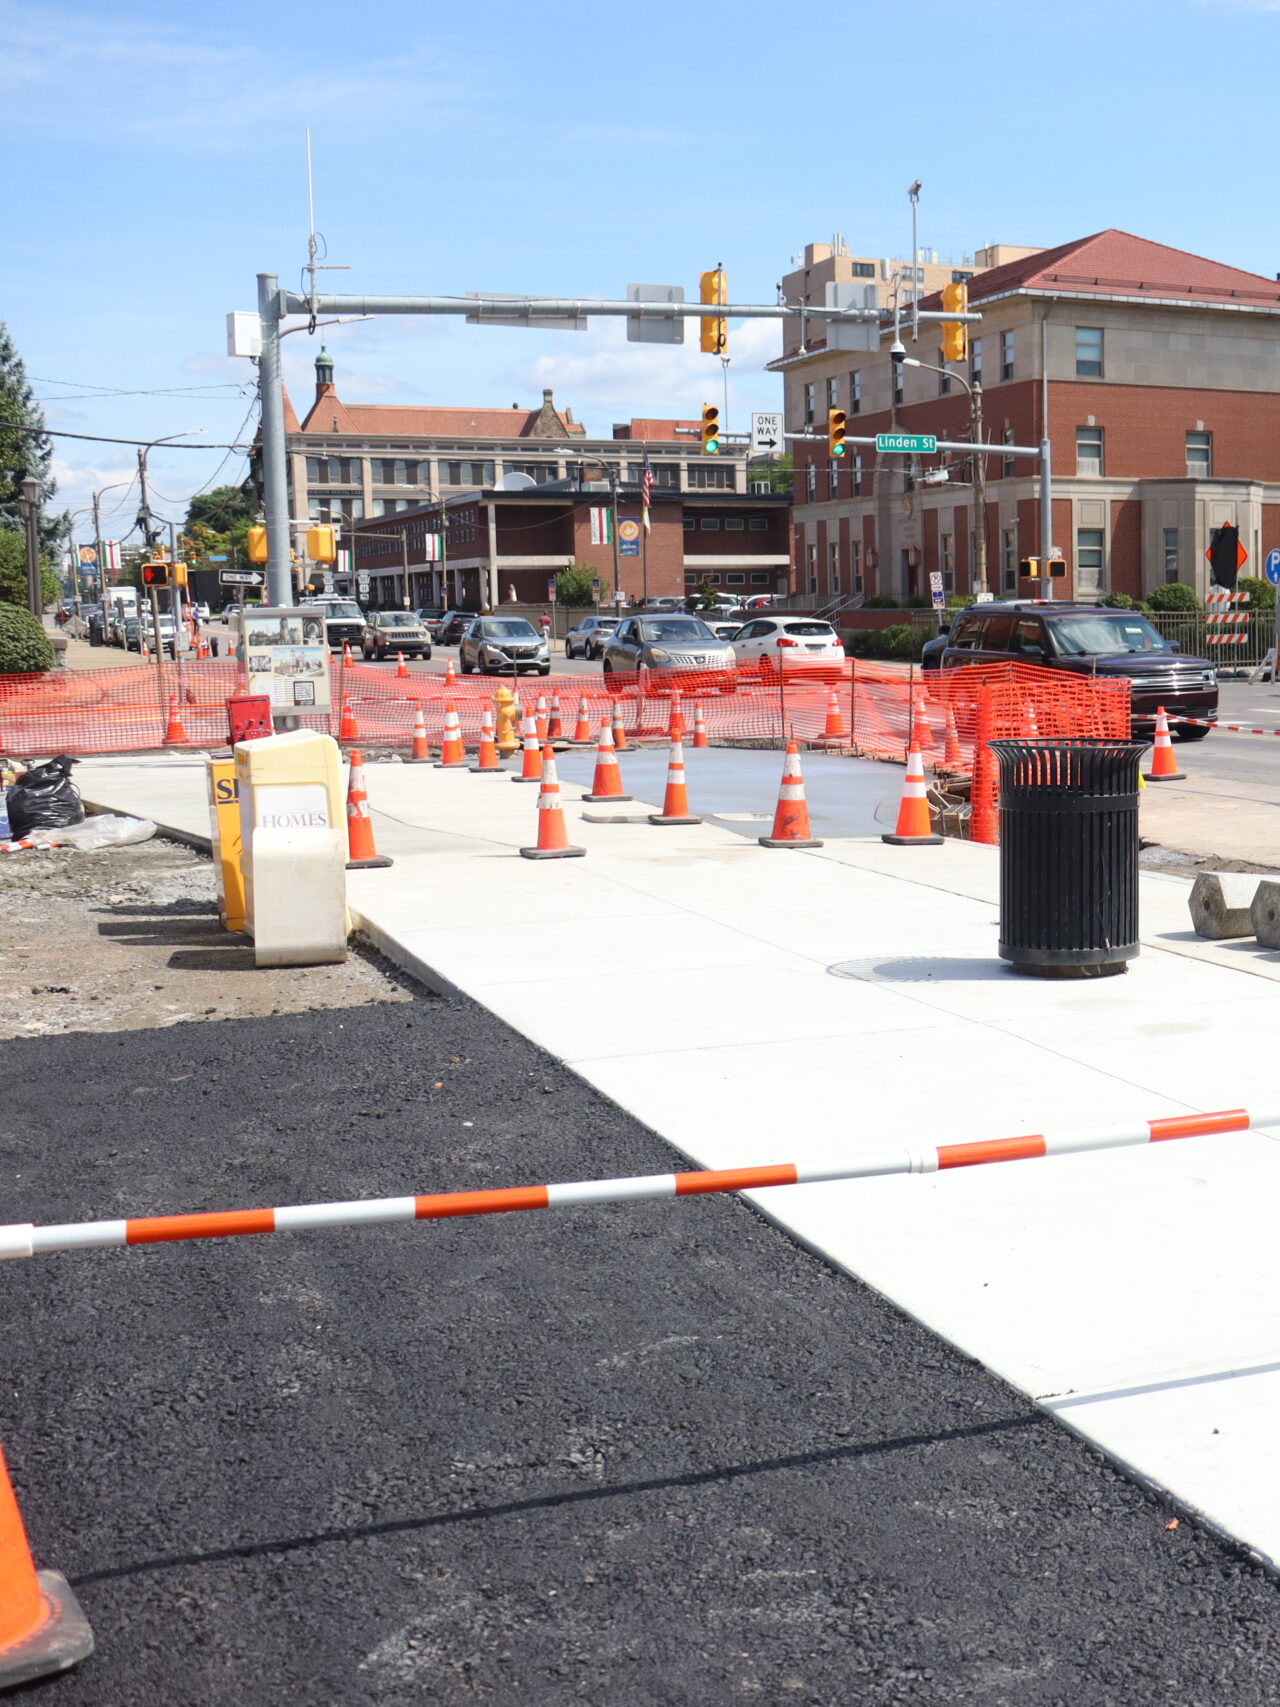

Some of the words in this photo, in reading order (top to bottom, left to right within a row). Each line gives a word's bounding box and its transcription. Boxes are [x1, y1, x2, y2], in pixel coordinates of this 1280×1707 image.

[757, 416, 778, 425] ONE
[757, 426, 778, 436] WAY
[878, 435, 917, 448] Linden
[922, 437, 934, 448] St
[1271, 552, 1280, 571] P
[262, 812, 327, 829] HOMES
